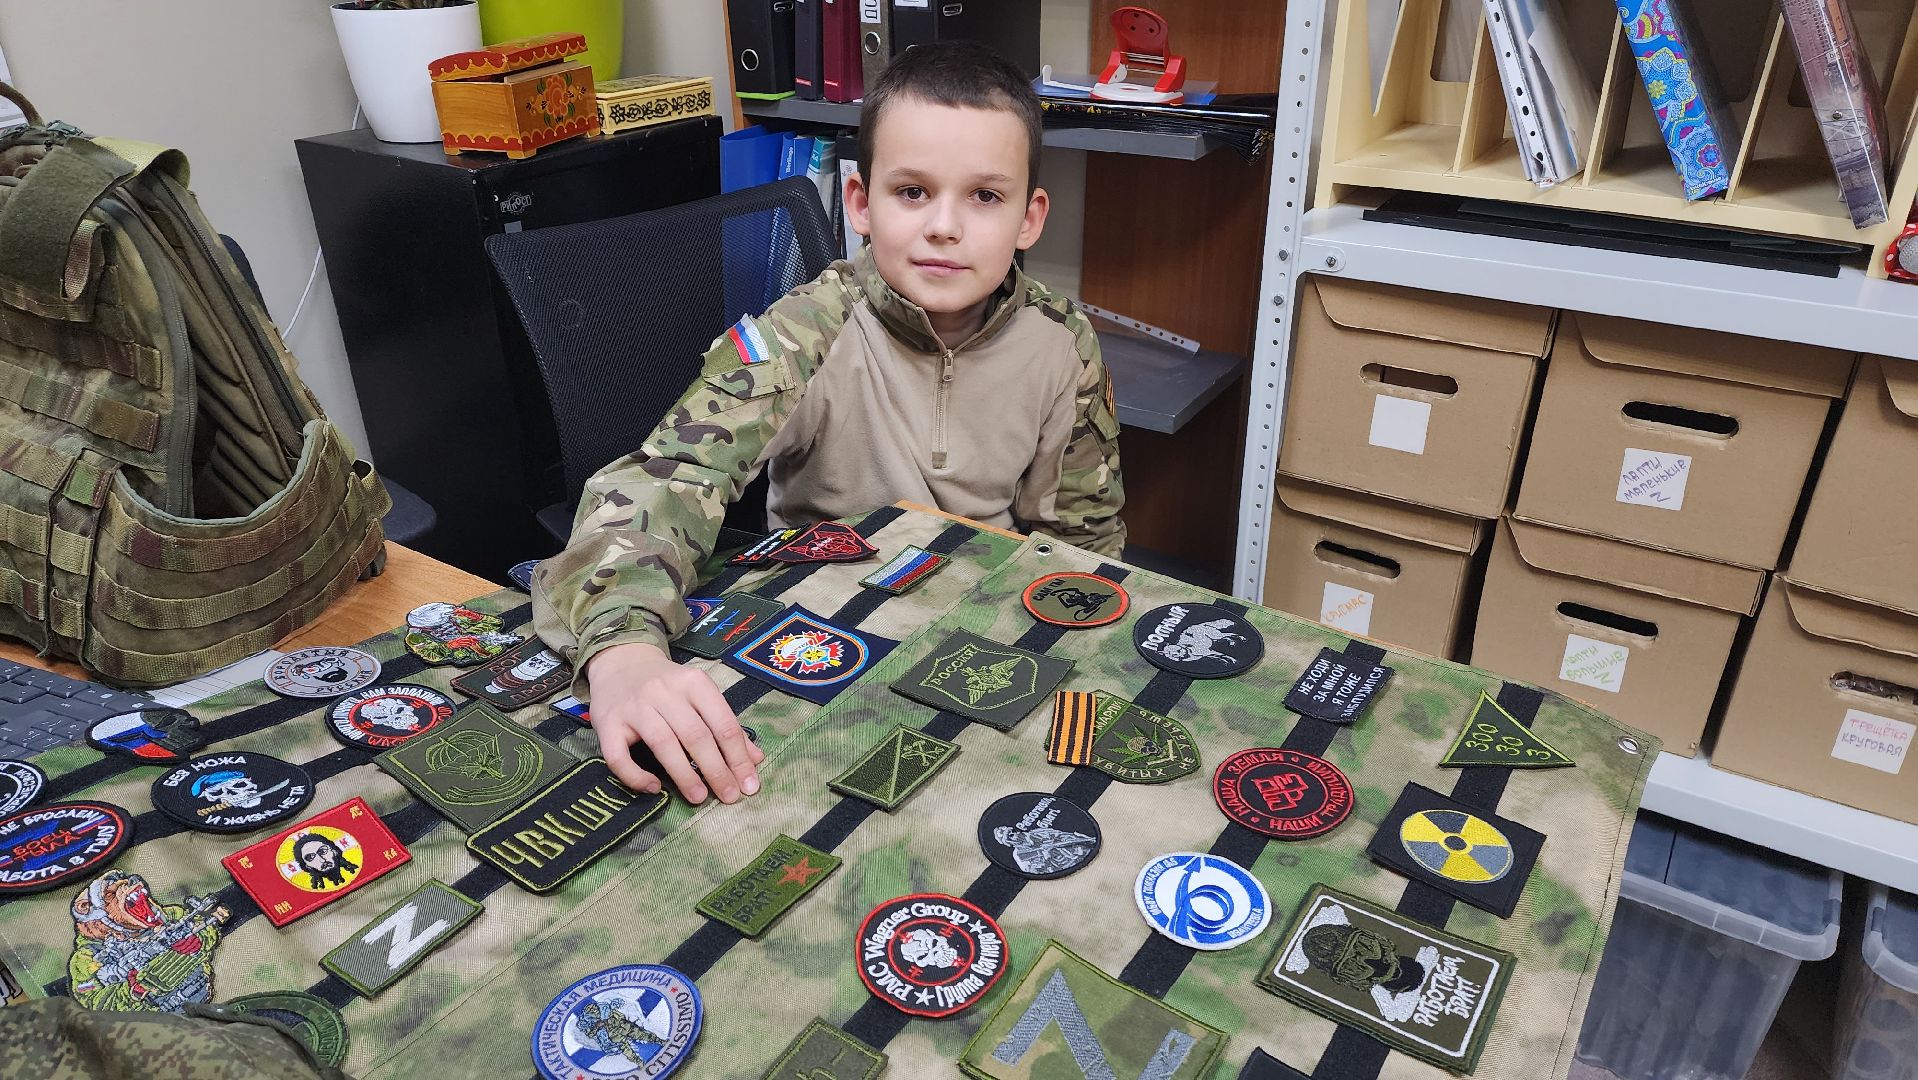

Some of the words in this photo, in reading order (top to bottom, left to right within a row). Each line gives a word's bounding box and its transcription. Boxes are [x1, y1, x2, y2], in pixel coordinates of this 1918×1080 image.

[932, 649, 977, 686] РОССИЯ
[1297, 681, 1315, 695] НЕ
[1306, 658, 1331, 683] ХОДИ
[1321, 663, 1348, 690] МНОЙ
[360, 687, 386, 700] НАМ
[510, 666, 572, 701] ПРОСТИ
[1313, 691, 1330, 702] ЗА
[1336, 673, 1361, 698] ТОЖЕ
[1341, 667, 1386, 717] ЗАБЛУДИЛСЯ
[1332, 697, 1345, 705] Я
[1465, 723, 1499, 752] 300
[1495, 736, 1524, 756] 30
[1841, 733, 1902, 757] КРУГОВАЯ
[1094, 757, 1167, 778] УБИТЫХ
[1228, 752, 1285, 775] ЗЕМЛЯ
[1526, 748, 1552, 760] 3
[163, 769, 190, 787] БЕЗ
[191, 755, 247, 772] НОЖА
[1221, 778, 1249, 817] НАША
[1269, 815, 1324, 831] НАШИ
[1306, 761, 1348, 818] ТРАДИЦИИ
[205, 814, 221, 824] И
[223, 809, 281, 826] ЖИЗНЬ
[277, 796, 301, 810] НЕ
[491, 812, 589, 869] ЧВК
[0, 865, 67, 882] АБОТА
[69, 855, 85, 866] В
[911, 902, 970, 926] Group
[361, 902, 451, 970] Z
[864, 906, 911, 962] Wagner
[867, 961, 914, 1002] PMC
[542, 992, 583, 1080] ТАКТИЧЕСКАЯ
[583, 970, 672, 993] МЕДИЦИНА
